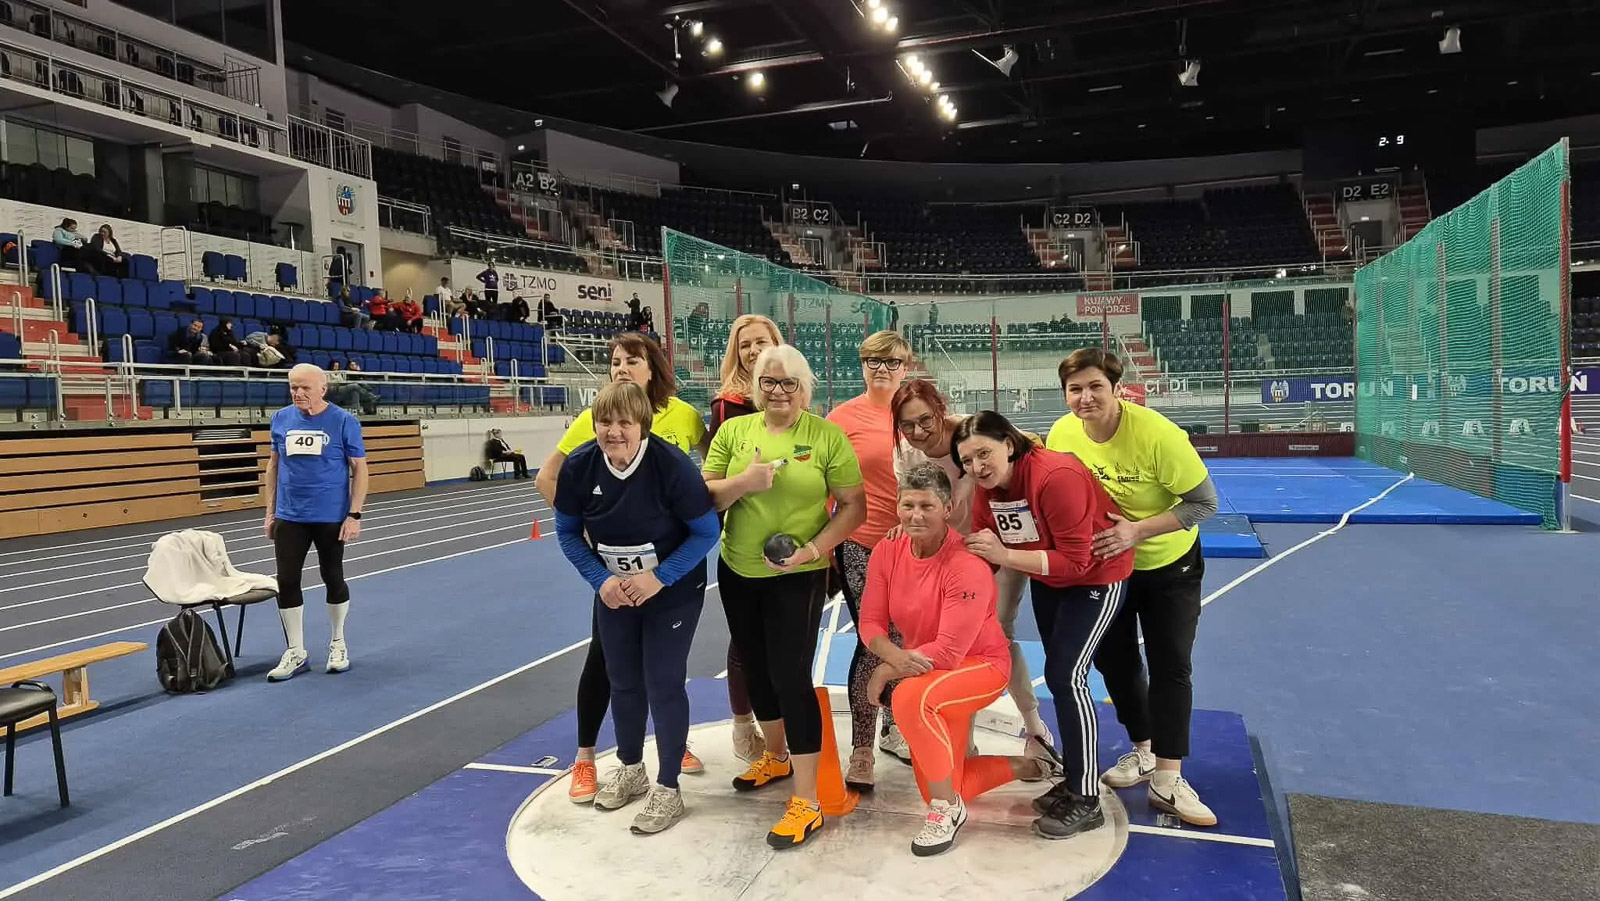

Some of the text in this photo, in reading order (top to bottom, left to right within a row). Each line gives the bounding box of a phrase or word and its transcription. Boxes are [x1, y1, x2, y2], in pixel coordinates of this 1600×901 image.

[515, 172, 557, 191] A2 B2
[1343, 183, 1389, 198] D2 E2
[792, 208, 829, 221] B2 C2
[1053, 212, 1091, 225] C2 D2
[520, 275, 557, 291] TZMO
[577, 283, 612, 301] seni
[1084, 295, 1123, 305] KUJAWY
[1084, 304, 1131, 314] POMORZE
[1169, 378, 1187, 392] D1
[294, 436, 314, 447] 40
[996, 513, 1023, 531] 85
[616, 555, 644, 572] 51
